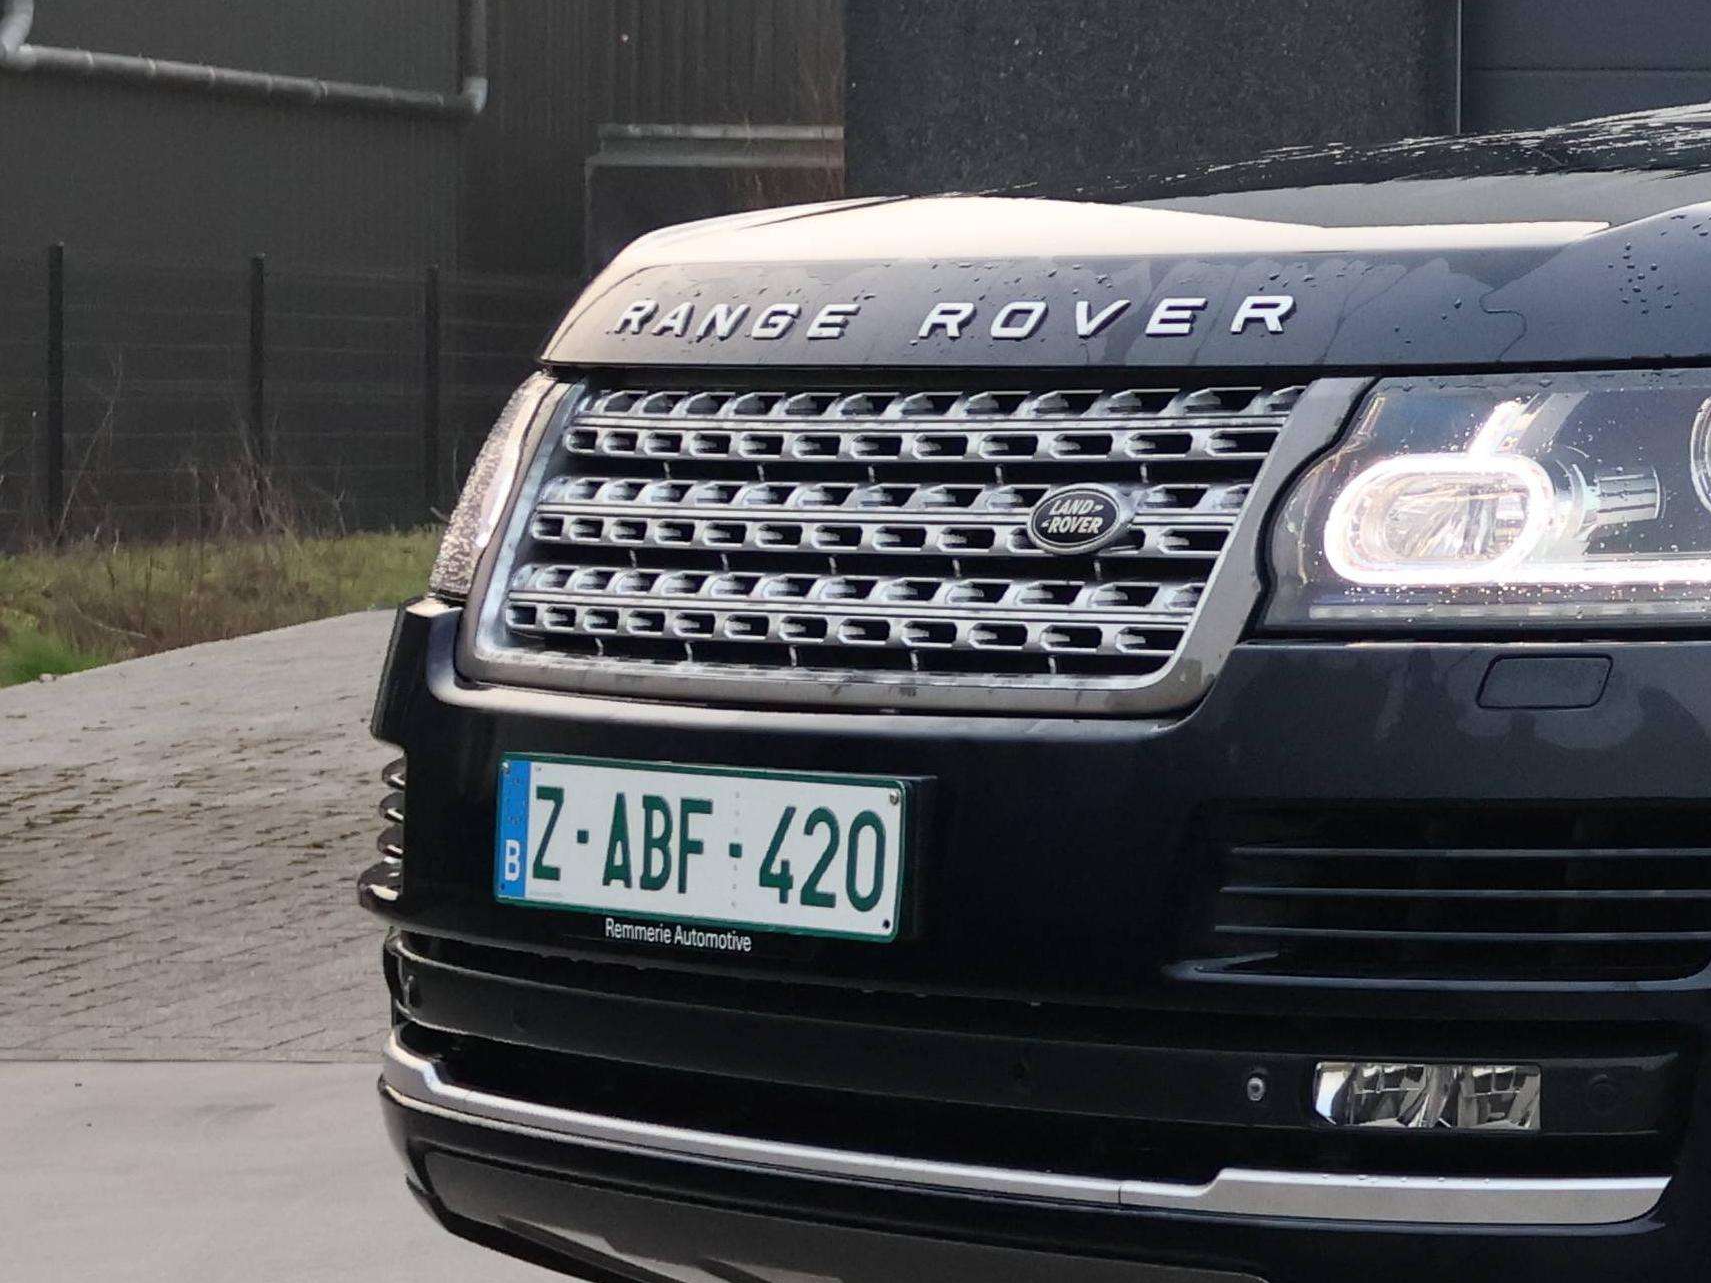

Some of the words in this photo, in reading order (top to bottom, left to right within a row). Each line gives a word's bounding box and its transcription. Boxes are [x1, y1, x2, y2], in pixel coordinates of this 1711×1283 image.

[613, 300, 863, 342] RANGE
[917, 294, 1298, 339] ROVER
[1046, 516, 1104, 534] ROVER
[1048, 499, 1095, 516] LAND
[504, 838, 521, 882] B
[605, 917, 672, 944] Remmerie
[673, 924, 752, 953] Automotive
